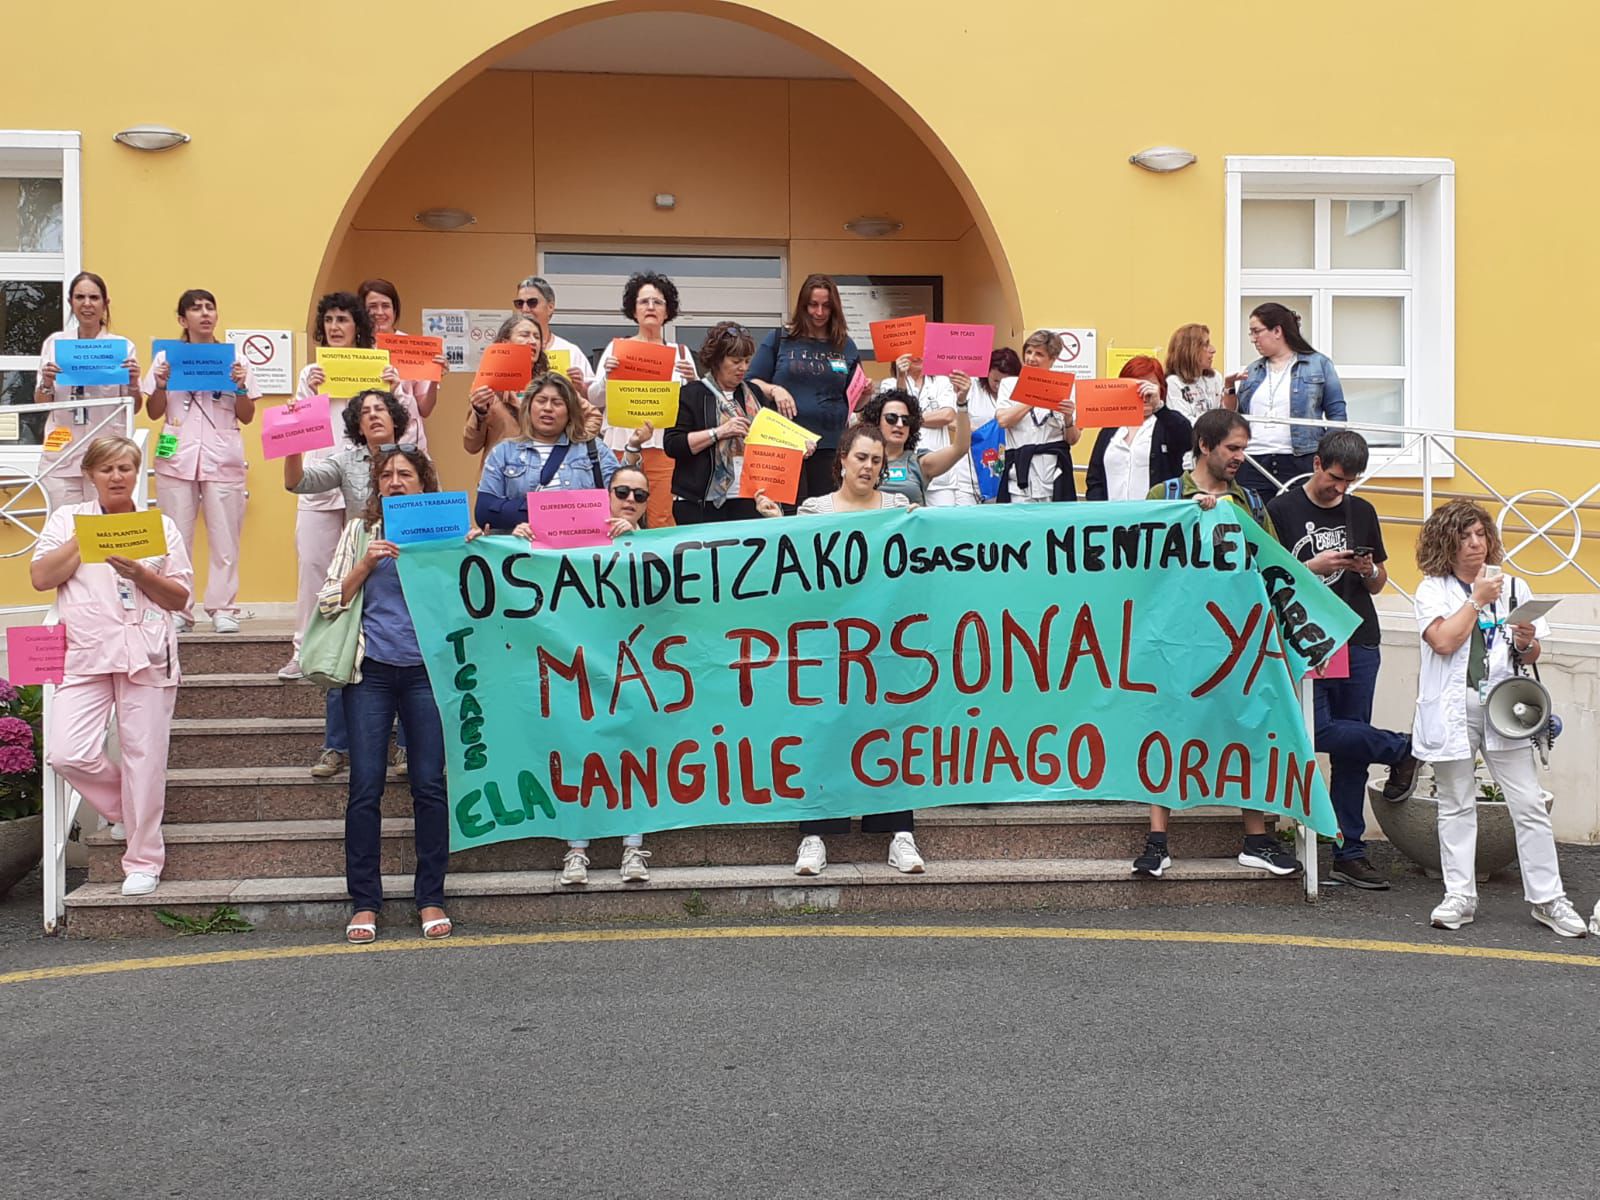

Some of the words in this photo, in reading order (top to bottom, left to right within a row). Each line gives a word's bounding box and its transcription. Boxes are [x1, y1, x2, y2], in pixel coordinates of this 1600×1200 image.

[446, 351, 464, 360] SIN
[285, 428, 306, 438] CUIDAR
[305, 425, 325, 433] MEJOR
[388, 501, 423, 509] NOSOTRAS
[424, 498, 466, 506] TRABAJAMOS
[540, 503, 576, 511] QUEREMOS
[112, 528, 148, 537] PLANTILLA
[400, 527, 435, 535] VOSOTRAS
[435, 524, 460, 532] DECIDÍS
[558, 528, 601, 536] PRECARIEDAD
[98, 541, 115, 549] MÁS
[115, 539, 149, 548] RECURSOS
[536, 624, 695, 721] MÁS
[724, 599, 1157, 708] PERSONAL
[1190, 600, 1294, 698] YA
[455, 769, 556, 839] ELA
